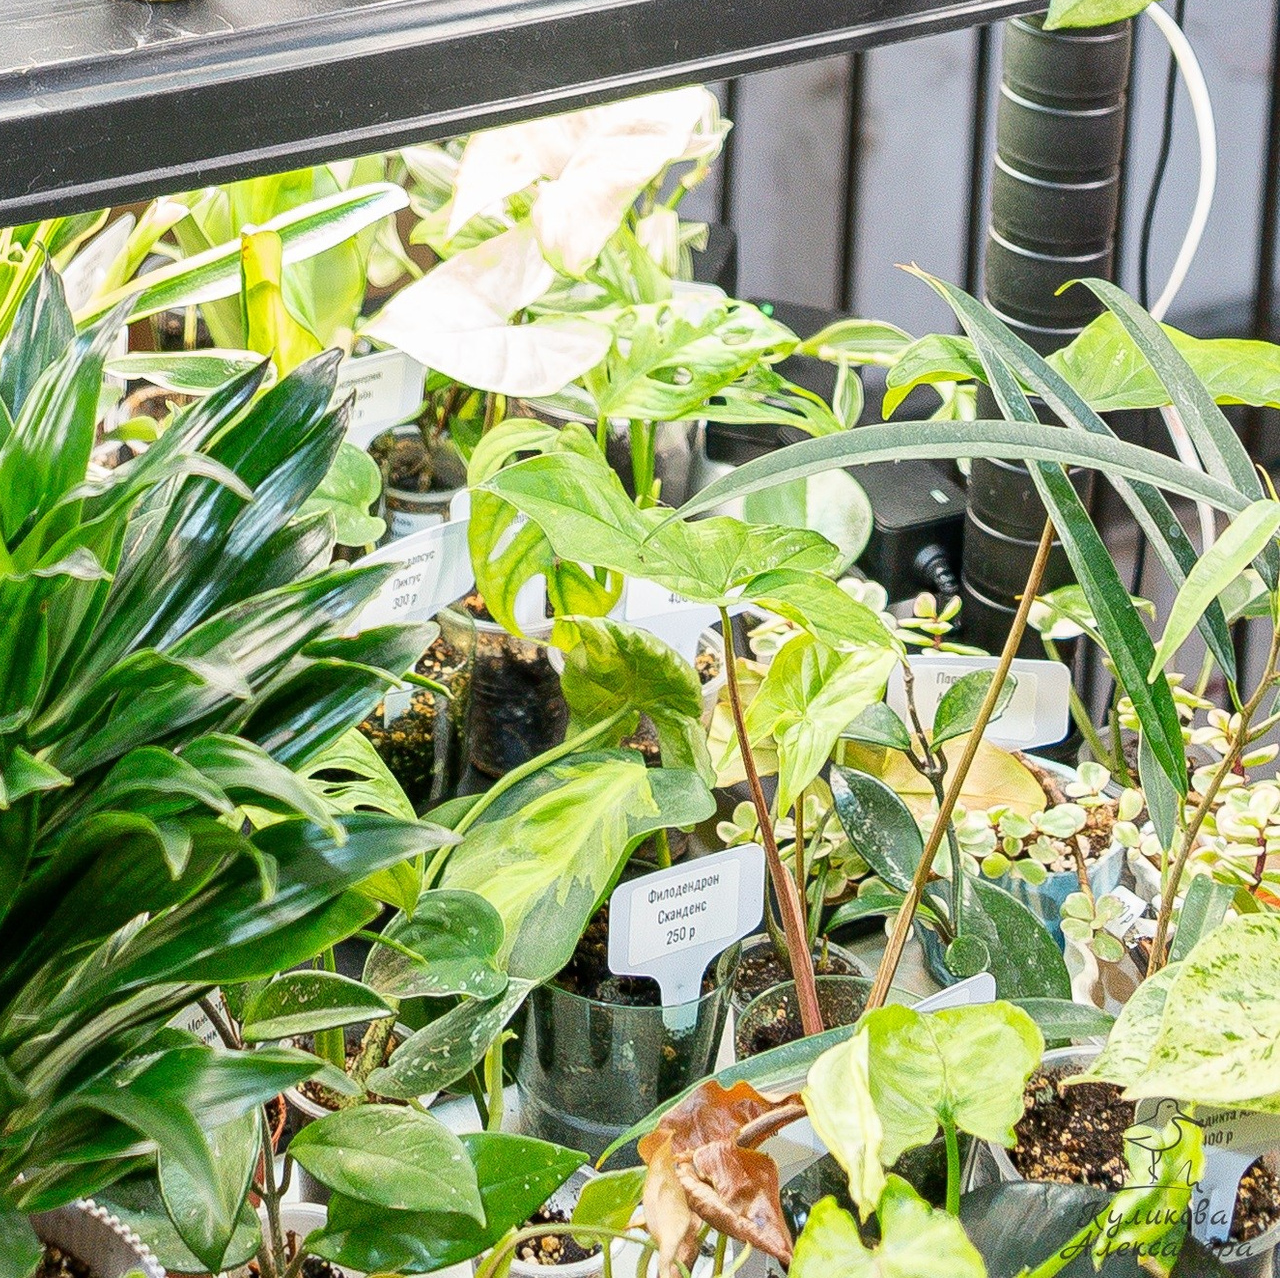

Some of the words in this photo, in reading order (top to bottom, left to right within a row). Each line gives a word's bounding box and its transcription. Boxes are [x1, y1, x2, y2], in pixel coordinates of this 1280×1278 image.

[648, 873, 720, 904] Филодендрон
[658, 900, 707, 925] Сканденс
[666, 927, 686, 946] 250
